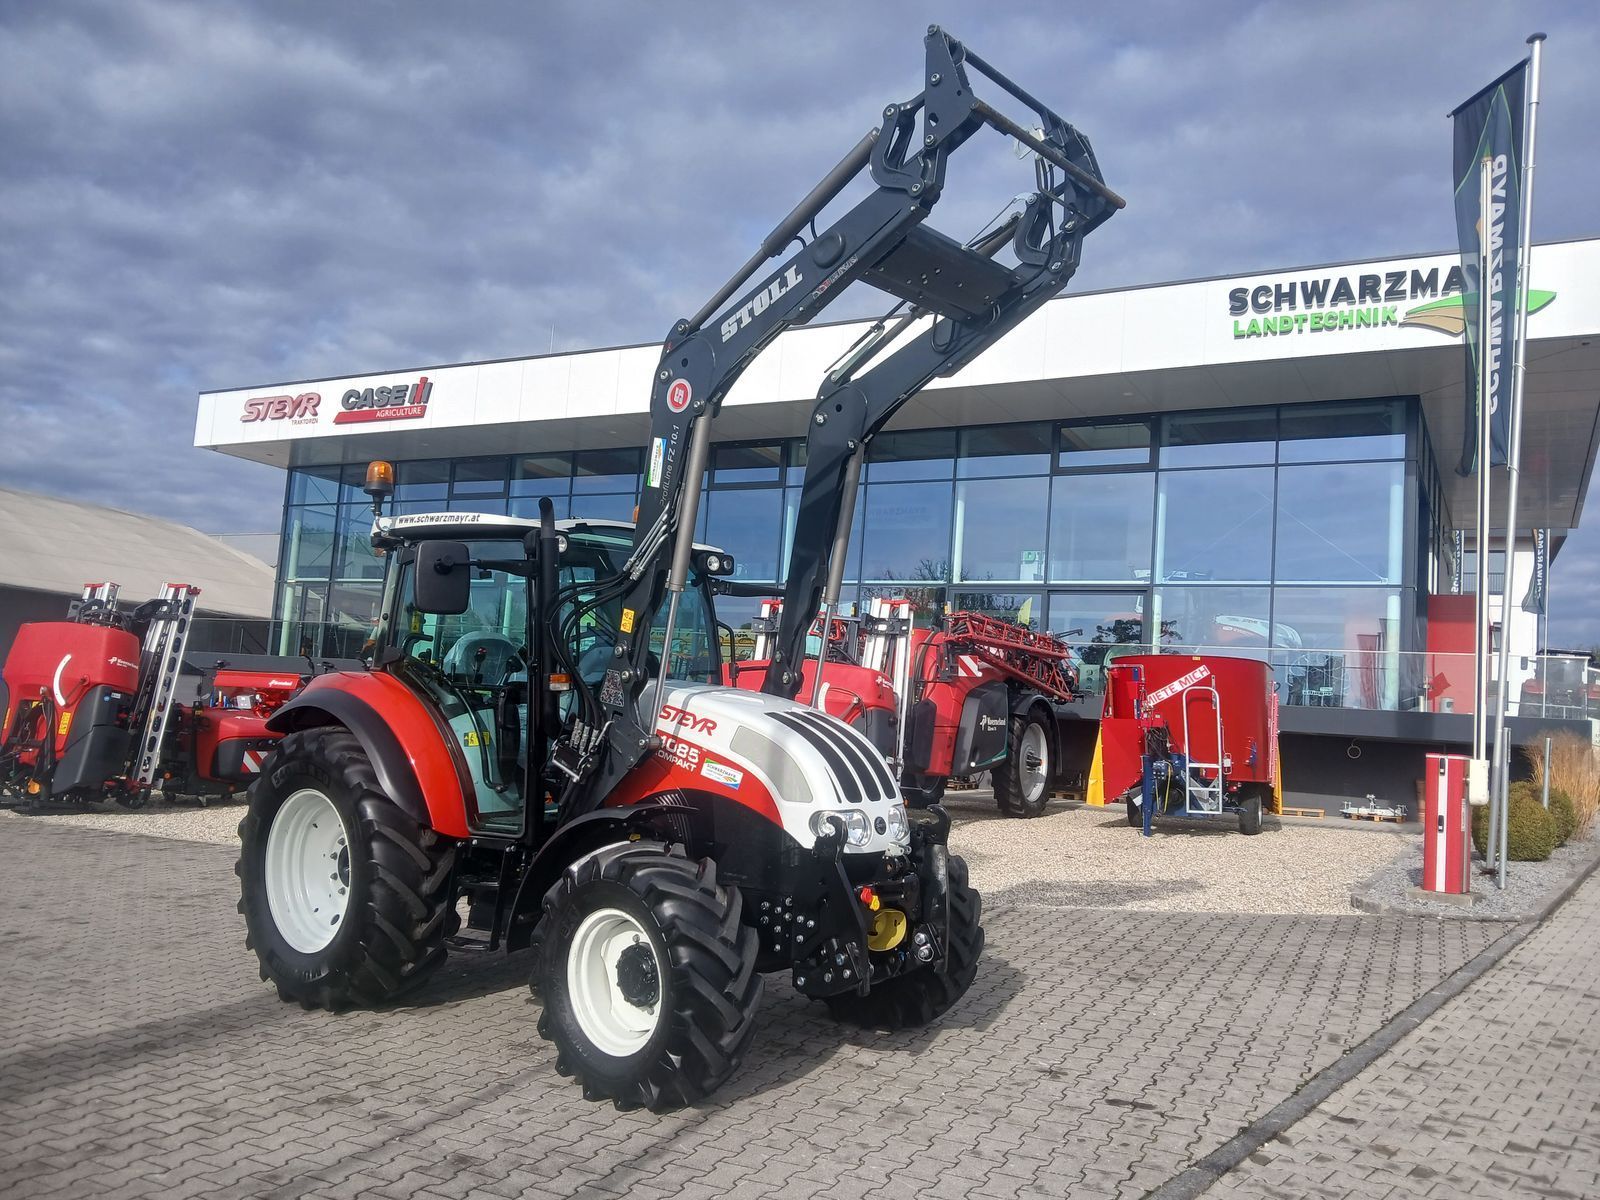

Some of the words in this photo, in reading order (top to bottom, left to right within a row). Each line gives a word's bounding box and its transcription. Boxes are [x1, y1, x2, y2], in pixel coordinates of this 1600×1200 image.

[1229, 265, 1480, 317] SCHWARZMA
[720, 264, 803, 343] STOLL
[1233, 305, 1398, 340] LANDTECHNIK
[240, 392, 321, 423] STEYR
[341, 384, 409, 410] CASE
[292, 417, 318, 426] TRAKTOREN
[376, 406, 422, 418] AGRICULTURE
[670, 424, 680, 446] 10.1
[667, 447, 676, 463] FZ
[398, 513, 481, 524] www.schwarzmayr.at
[1179, 666, 1209, 688] MICH
[659, 704, 718, 736] STEYR
[656, 749, 697, 772] OMPAKT
[660, 735, 701, 763] 1085
